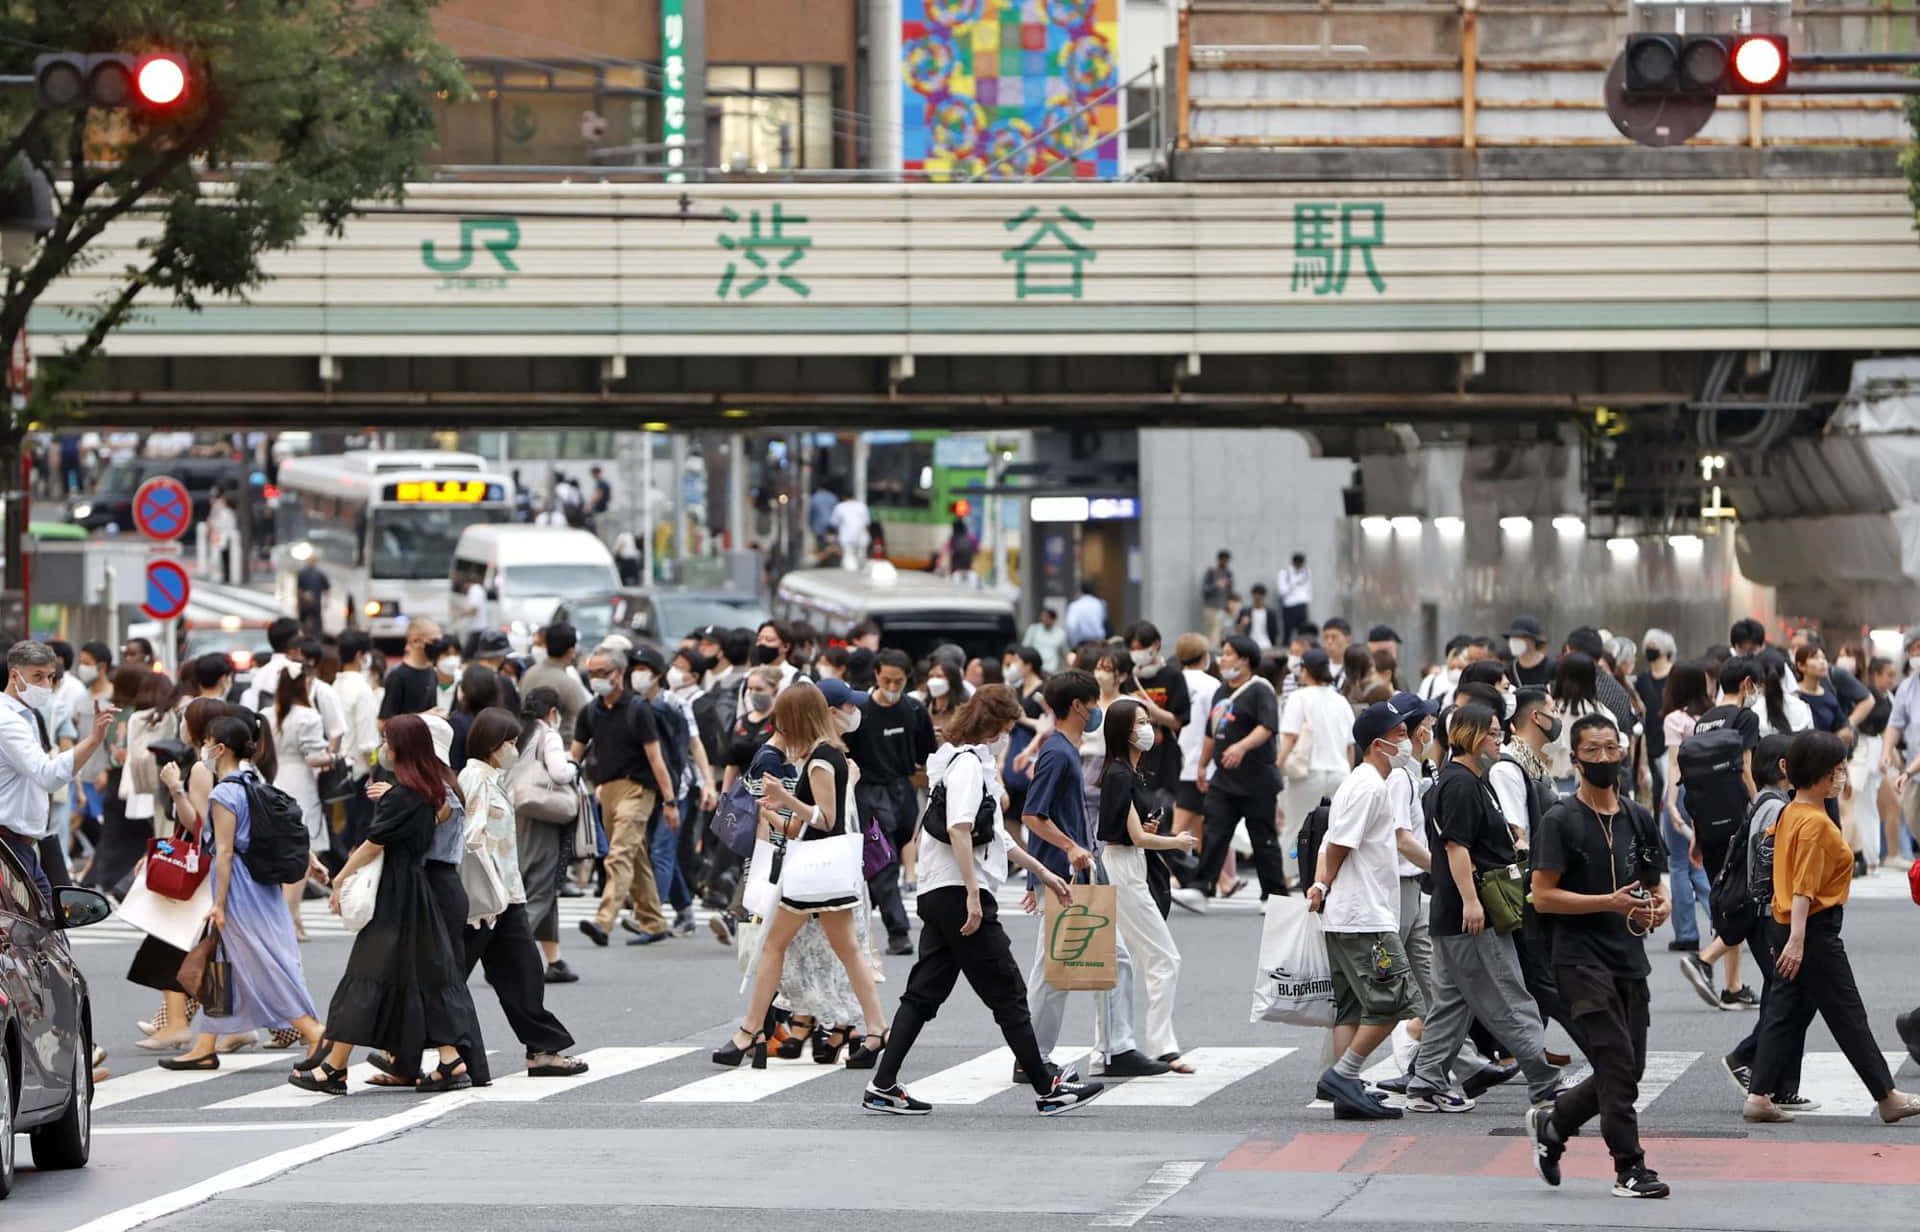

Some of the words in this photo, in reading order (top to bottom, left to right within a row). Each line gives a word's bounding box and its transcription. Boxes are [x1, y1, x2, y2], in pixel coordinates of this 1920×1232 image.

[421, 216, 520, 271] JR
[717, 203, 1387, 298] 渋谷駅
